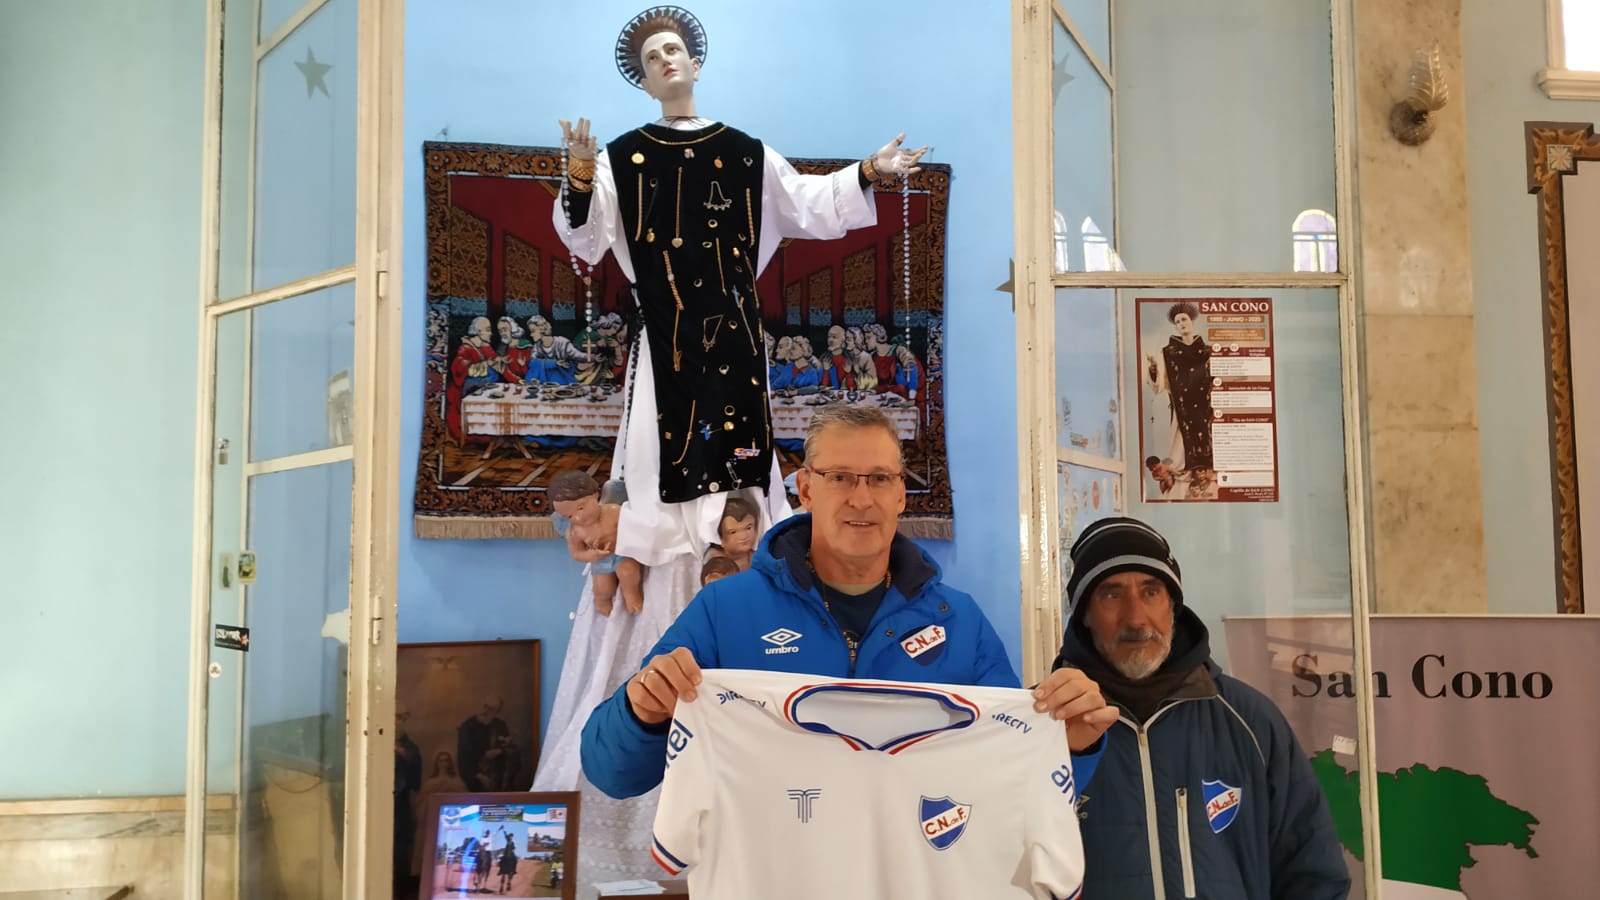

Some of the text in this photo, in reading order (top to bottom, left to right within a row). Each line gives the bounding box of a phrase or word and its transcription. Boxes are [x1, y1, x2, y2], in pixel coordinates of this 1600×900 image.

[1201, 302, 1269, 312] SAN CONO
[765, 645, 800, 655] umbro
[1292, 653, 1554, 700] San Cono
[991, 712, 1033, 734] RECTV
